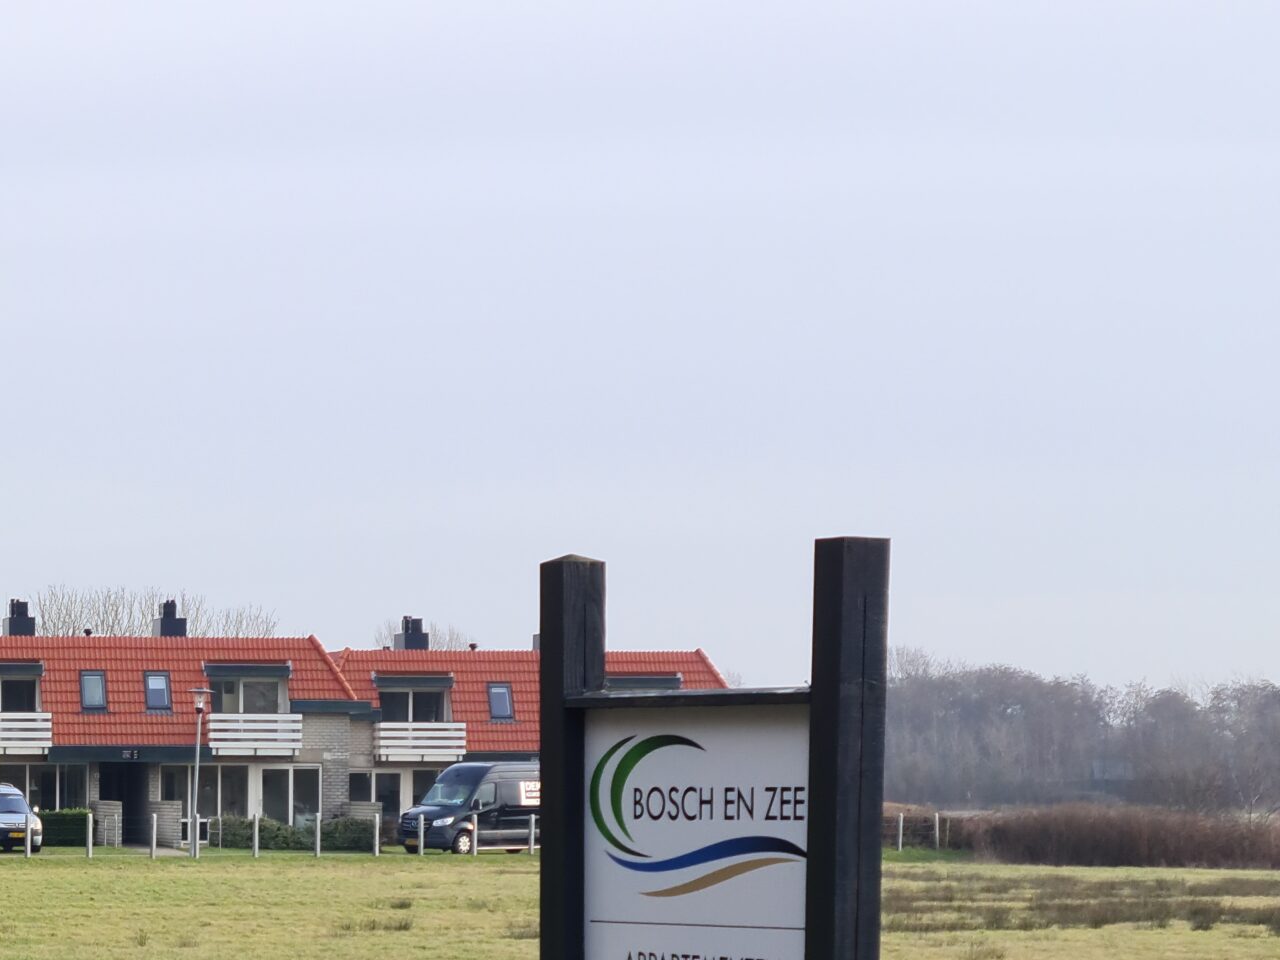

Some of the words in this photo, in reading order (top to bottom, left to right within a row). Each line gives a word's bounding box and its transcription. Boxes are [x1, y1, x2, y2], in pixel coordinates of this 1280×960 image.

[633, 786, 714, 821] BOSCH
[724, 786, 755, 821] EN
[764, 786, 806, 821] ZEE
